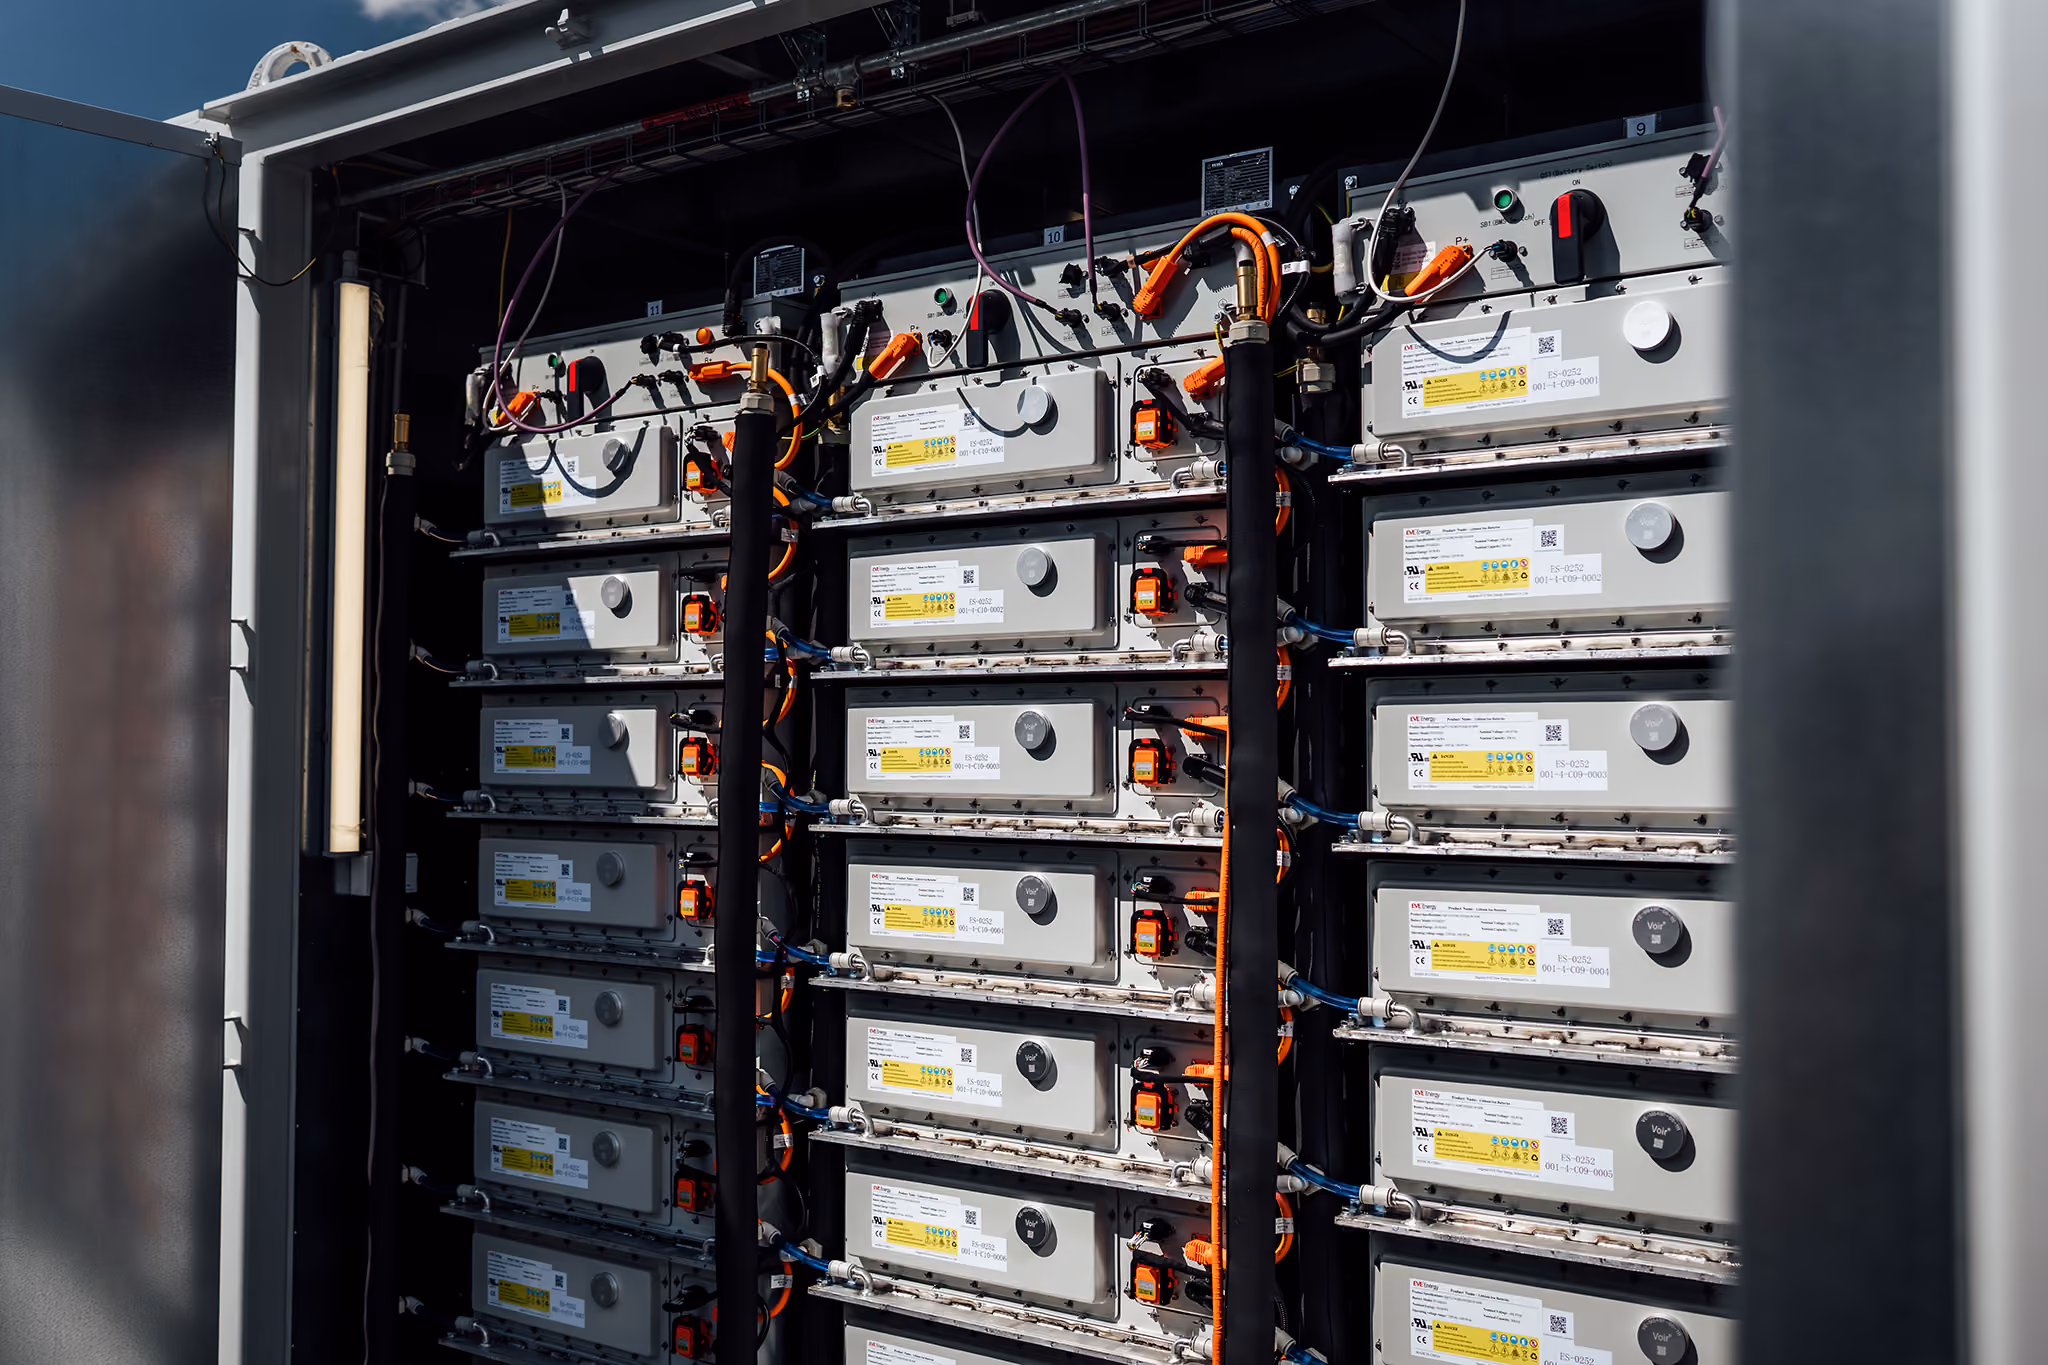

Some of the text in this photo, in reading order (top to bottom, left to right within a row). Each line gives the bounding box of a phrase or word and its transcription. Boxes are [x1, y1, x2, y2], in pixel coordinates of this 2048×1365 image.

[1636, 122, 1646, 136] 9
[1533, 218, 1546, 227] OFF
[1047, 231, 1061, 244] 10
[1455, 236, 1469, 245] P+
[650, 304, 661, 315] 11
[1547, 367, 1582, 380] ES-0252
[1407, 396, 1418, 405] CE
[1550, 563, 1585, 574] ES-0252
[1409, 581, 1420, 590] CE
[1555, 759, 1590, 769] ES-0252
[1413, 769, 1424, 778] CE
[1415, 956, 1425, 965] CE
[1557, 954, 1592, 964] ES-0252
[1425, 1090, 1440, 1099] Energy
[1417, 1144, 1428, 1153] CE
[1560, 1153, 1596, 1166] ES-0252
[1423, 1282, 1439, 1291] Energy
[1416, 1335, 1427, 1344] CE
[1559, 1352, 1595, 1365] ES-0252
